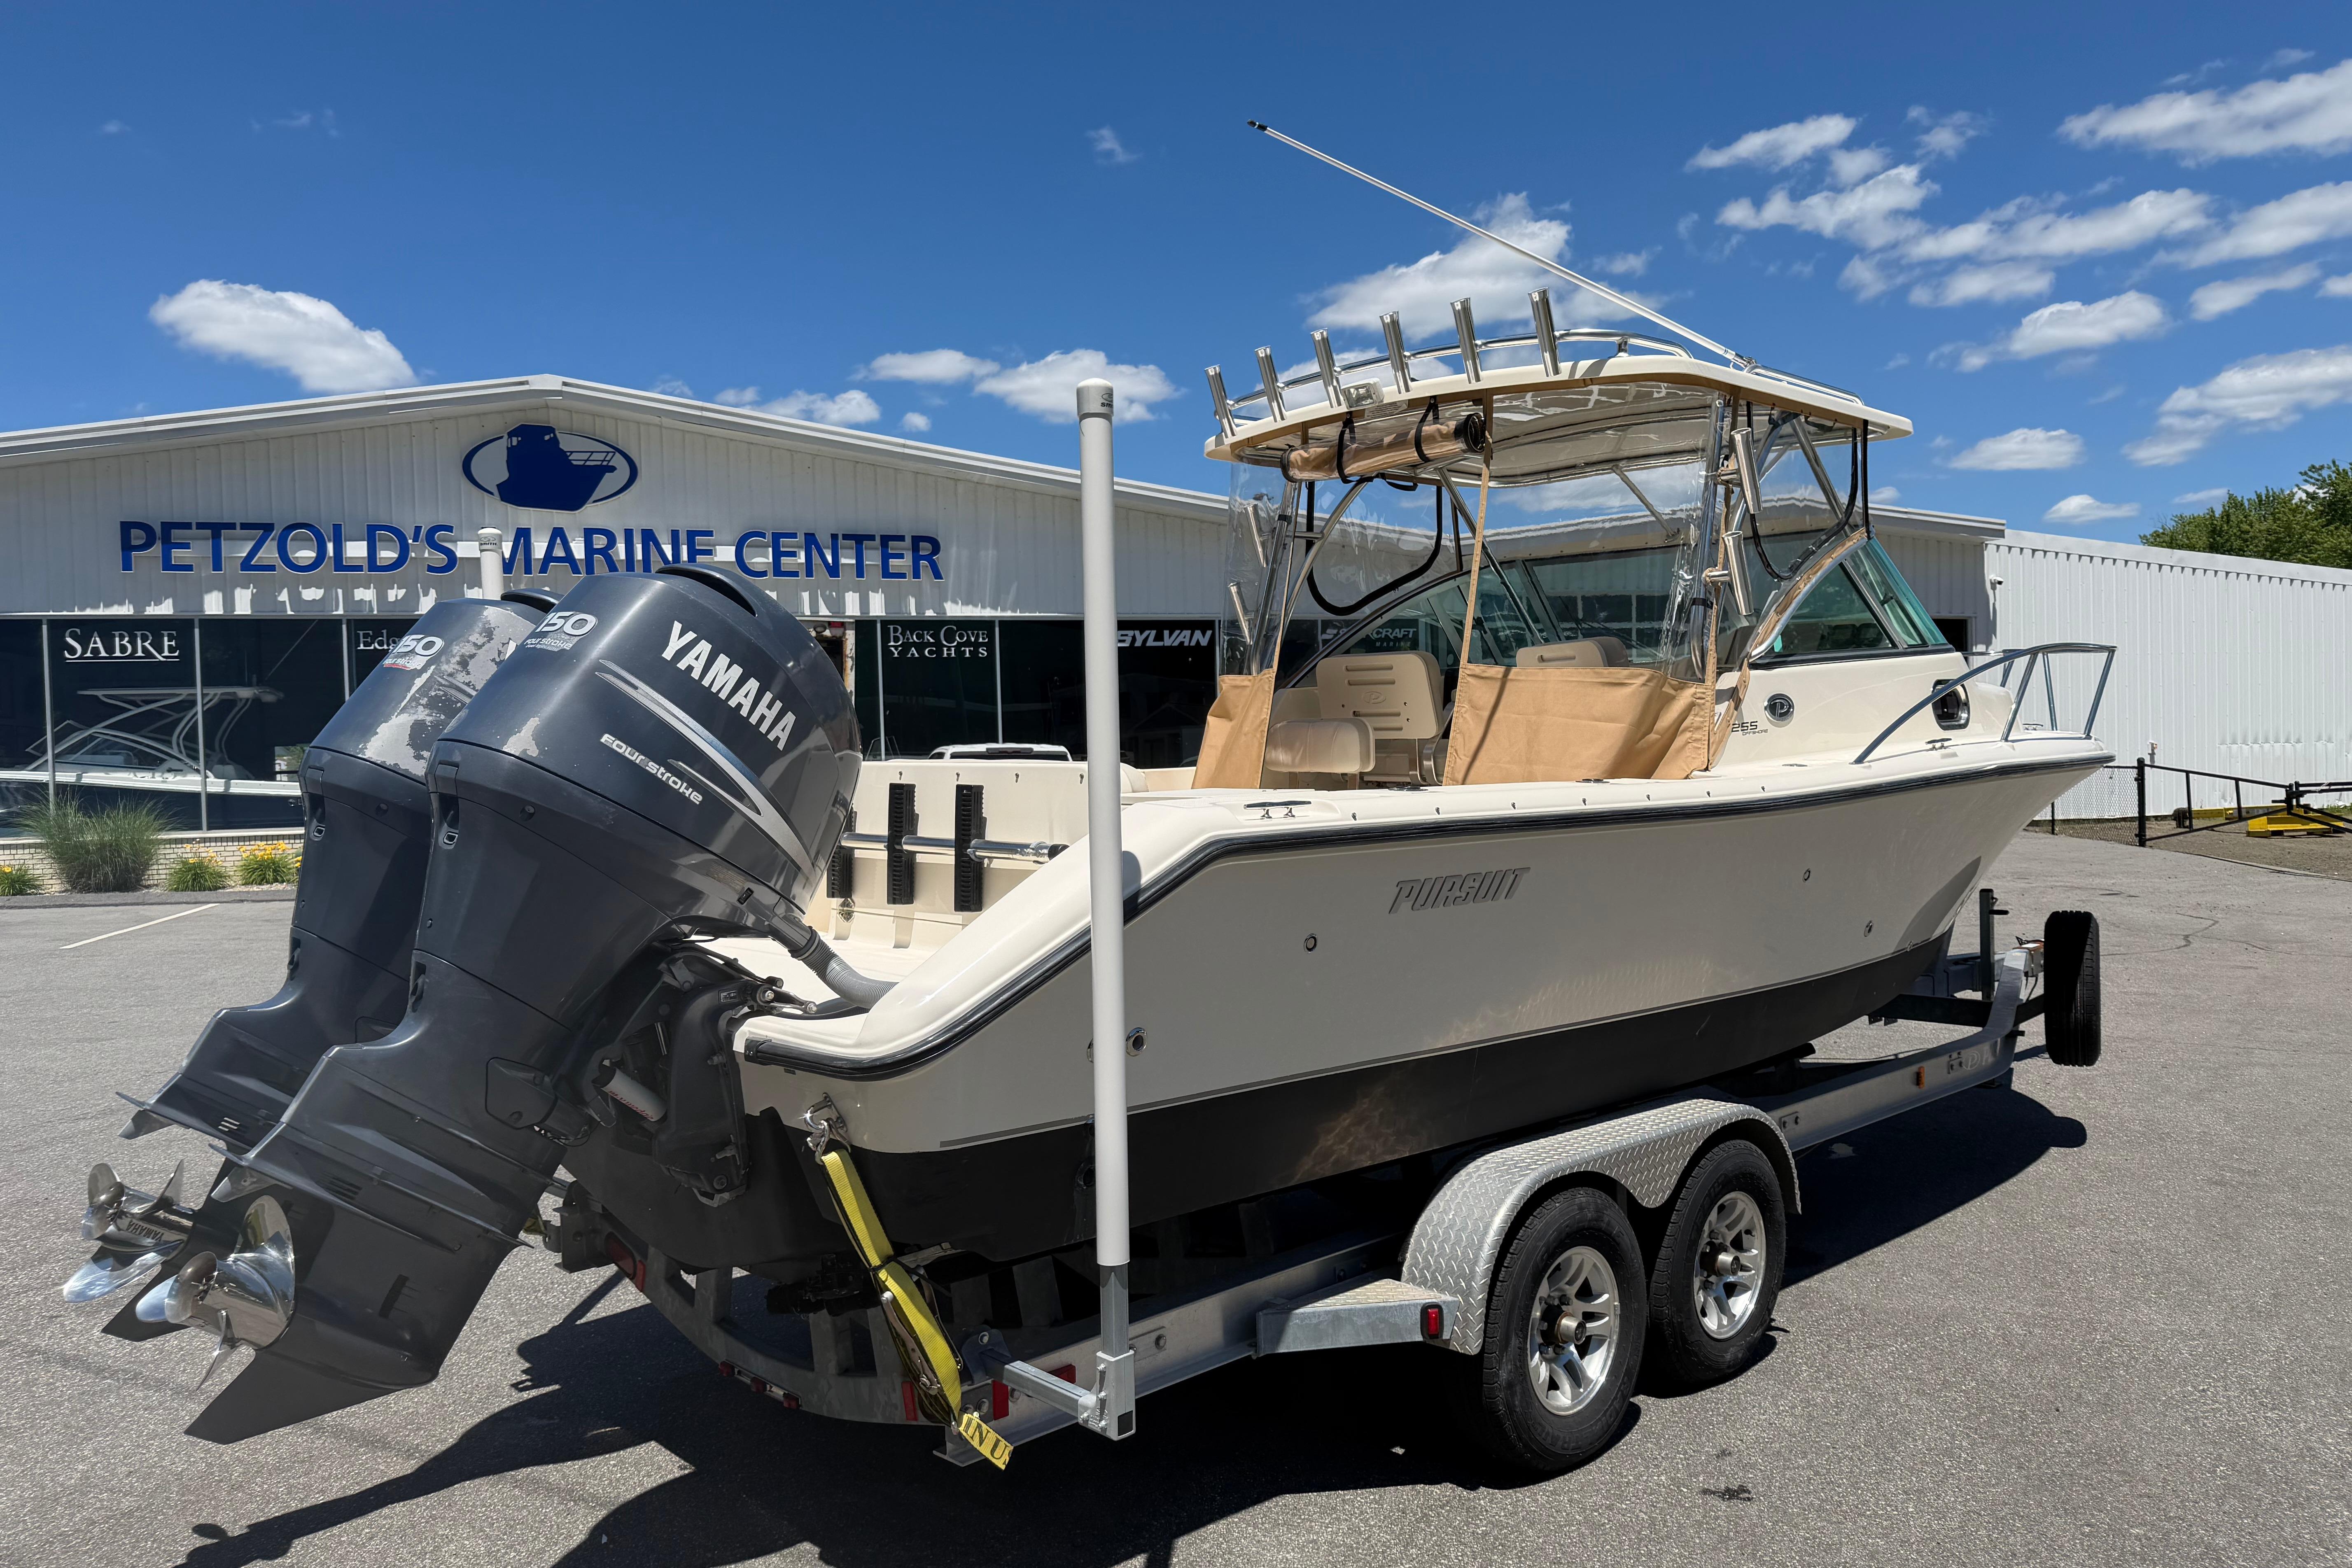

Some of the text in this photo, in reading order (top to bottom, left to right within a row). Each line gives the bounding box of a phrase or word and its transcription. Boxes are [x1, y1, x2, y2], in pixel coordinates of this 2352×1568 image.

[119, 520, 459, 575] PETZOLD'S
[734, 530, 945, 581] CENTER
[535, 611, 597, 636] 150
[887, 625, 988, 646] BACK COVE
[64, 627, 180, 660] SABRE
[1118, 630, 1212, 646] SYLVAN
[889, 647, 987, 657] YACHTS
[660, 620, 797, 751] YAMAHA
[1731, 721, 1758, 733] 255
[1388, 867, 1531, 915] PURSUIT
[126, 1219, 164, 1242] YAMAHA
[963, 1415, 992, 1447] IN
